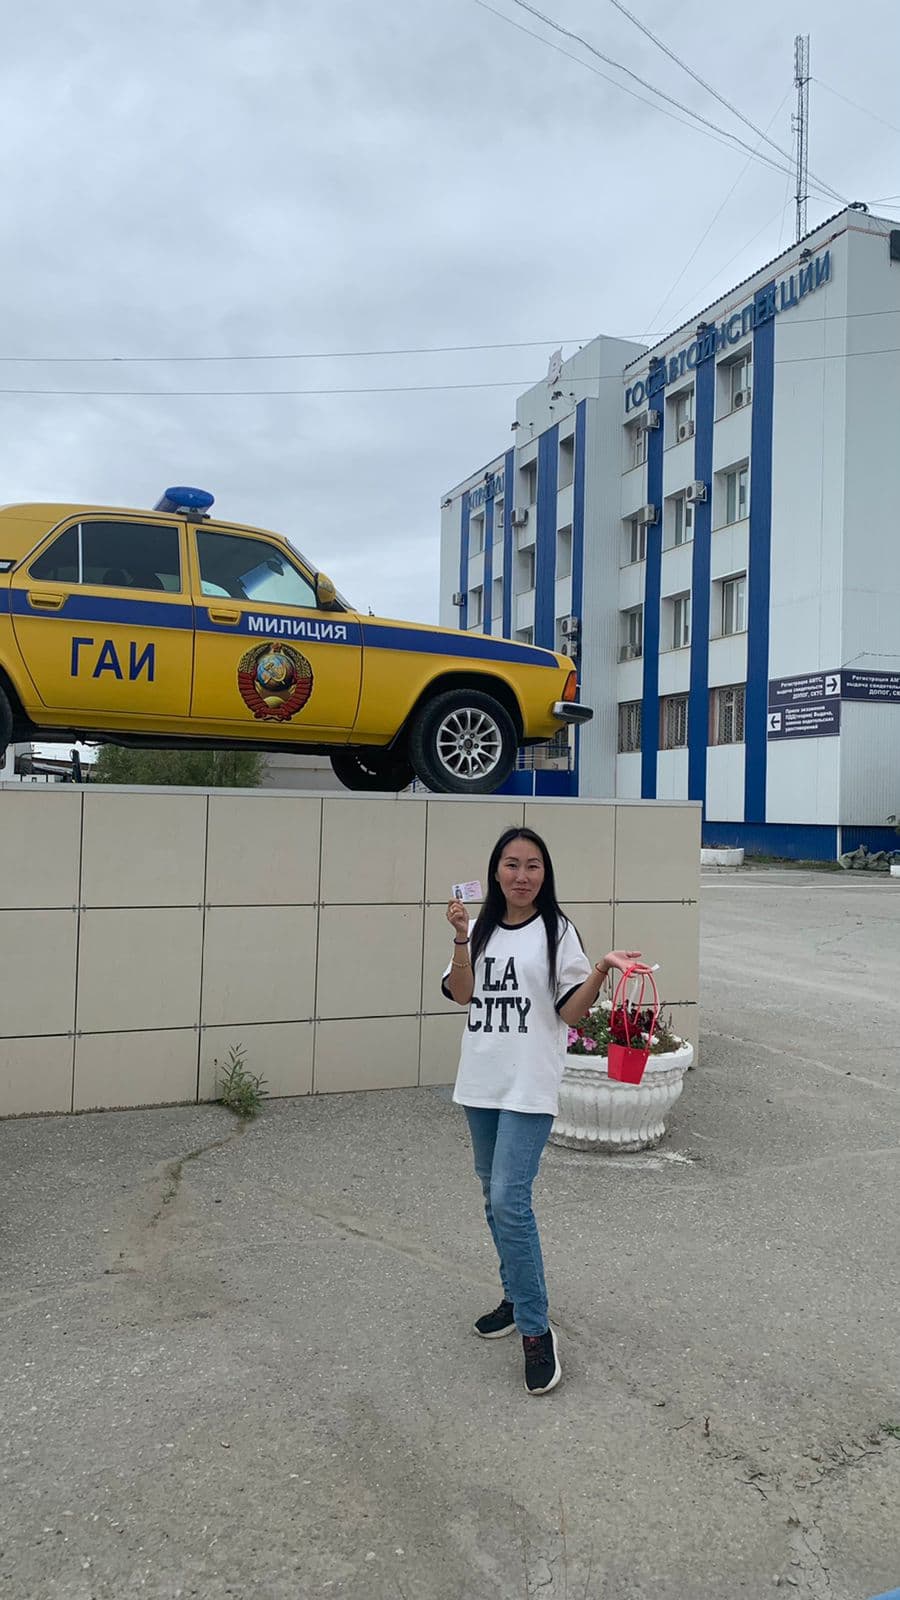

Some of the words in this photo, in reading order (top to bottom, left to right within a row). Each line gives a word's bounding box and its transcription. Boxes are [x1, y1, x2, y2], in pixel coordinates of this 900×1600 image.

[624, 250, 832, 413] ГОСАВТОИНСПЕКЦИИ
[248, 616, 347, 640] МИЛИЦИЯ
[70, 636, 155, 682] ГАИ
[483, 957, 518, 991] LA
[468, 996, 531, 1034] CITY
